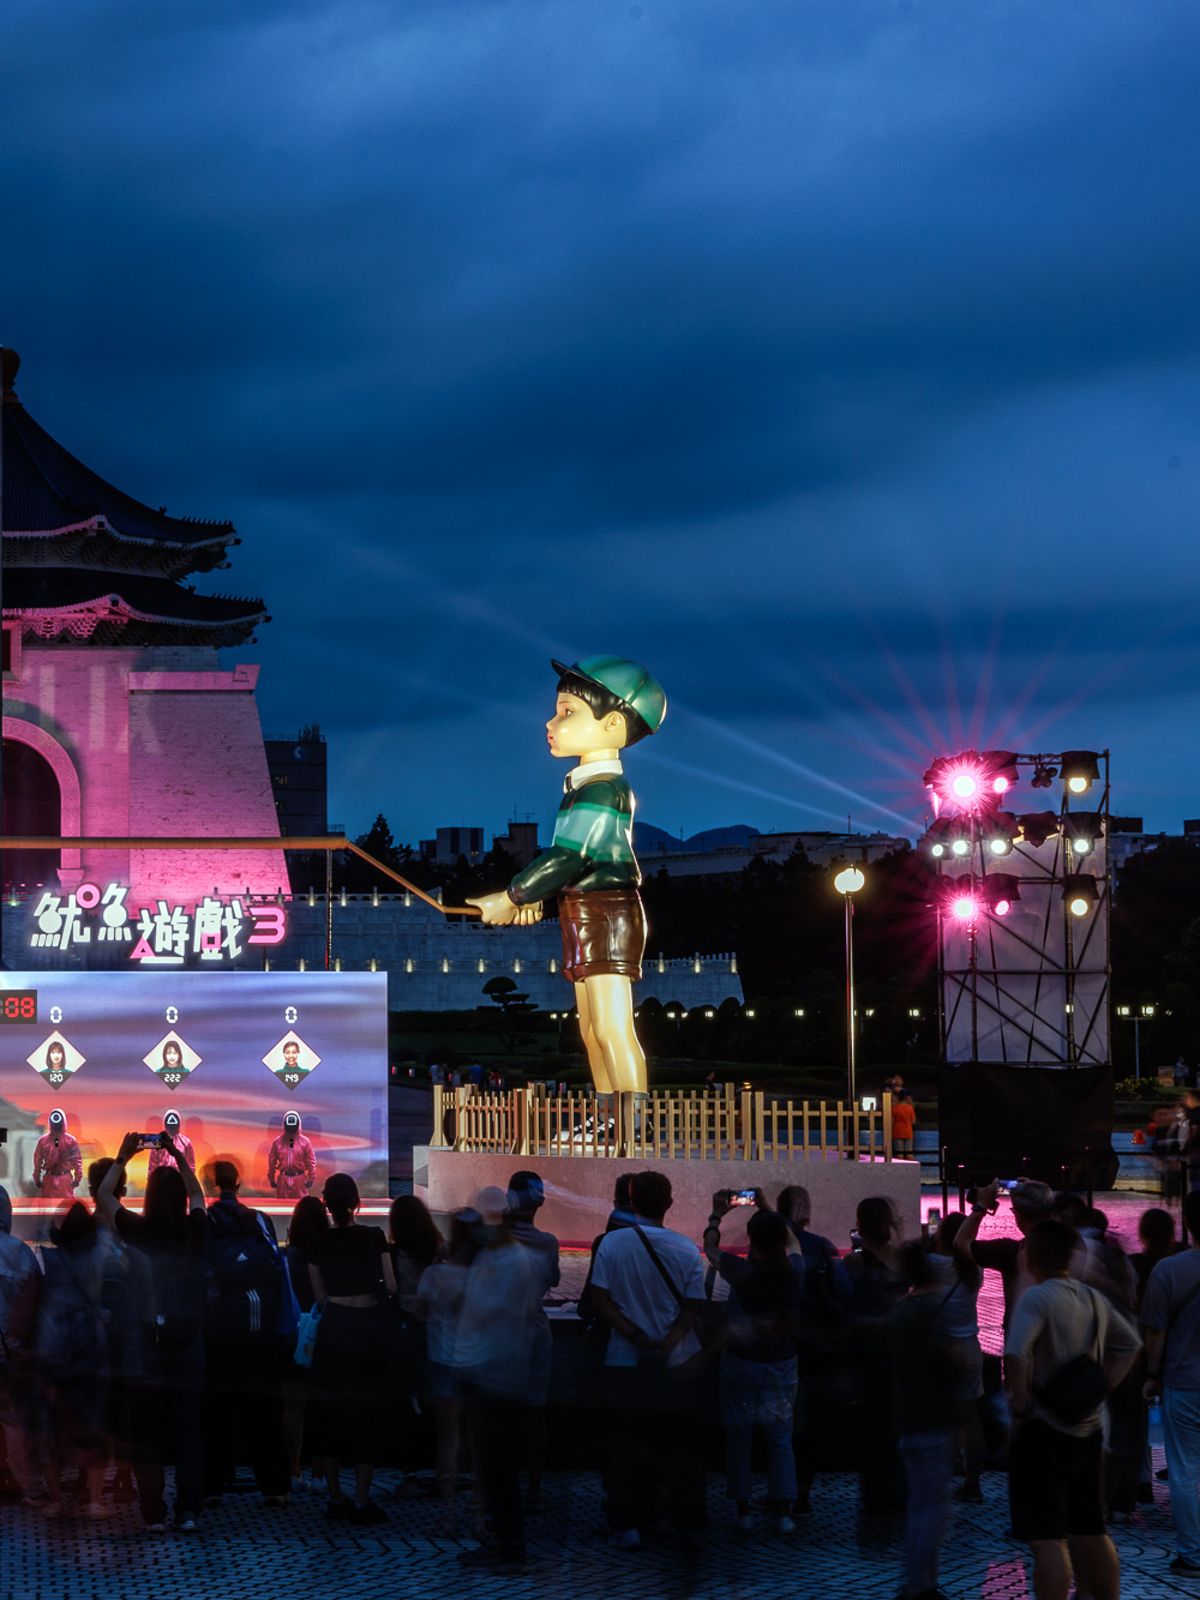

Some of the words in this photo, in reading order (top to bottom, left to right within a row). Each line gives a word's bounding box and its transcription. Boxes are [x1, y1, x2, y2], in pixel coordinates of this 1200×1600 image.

[50, 1006, 62, 1024] 0
[166, 1006, 179, 1024] 0
[285, 1006, 297, 1024] 0
[49, 1073, 64, 1083] 120
[164, 1073, 181, 1083] 222
[285, 1073, 300, 1083] 149
